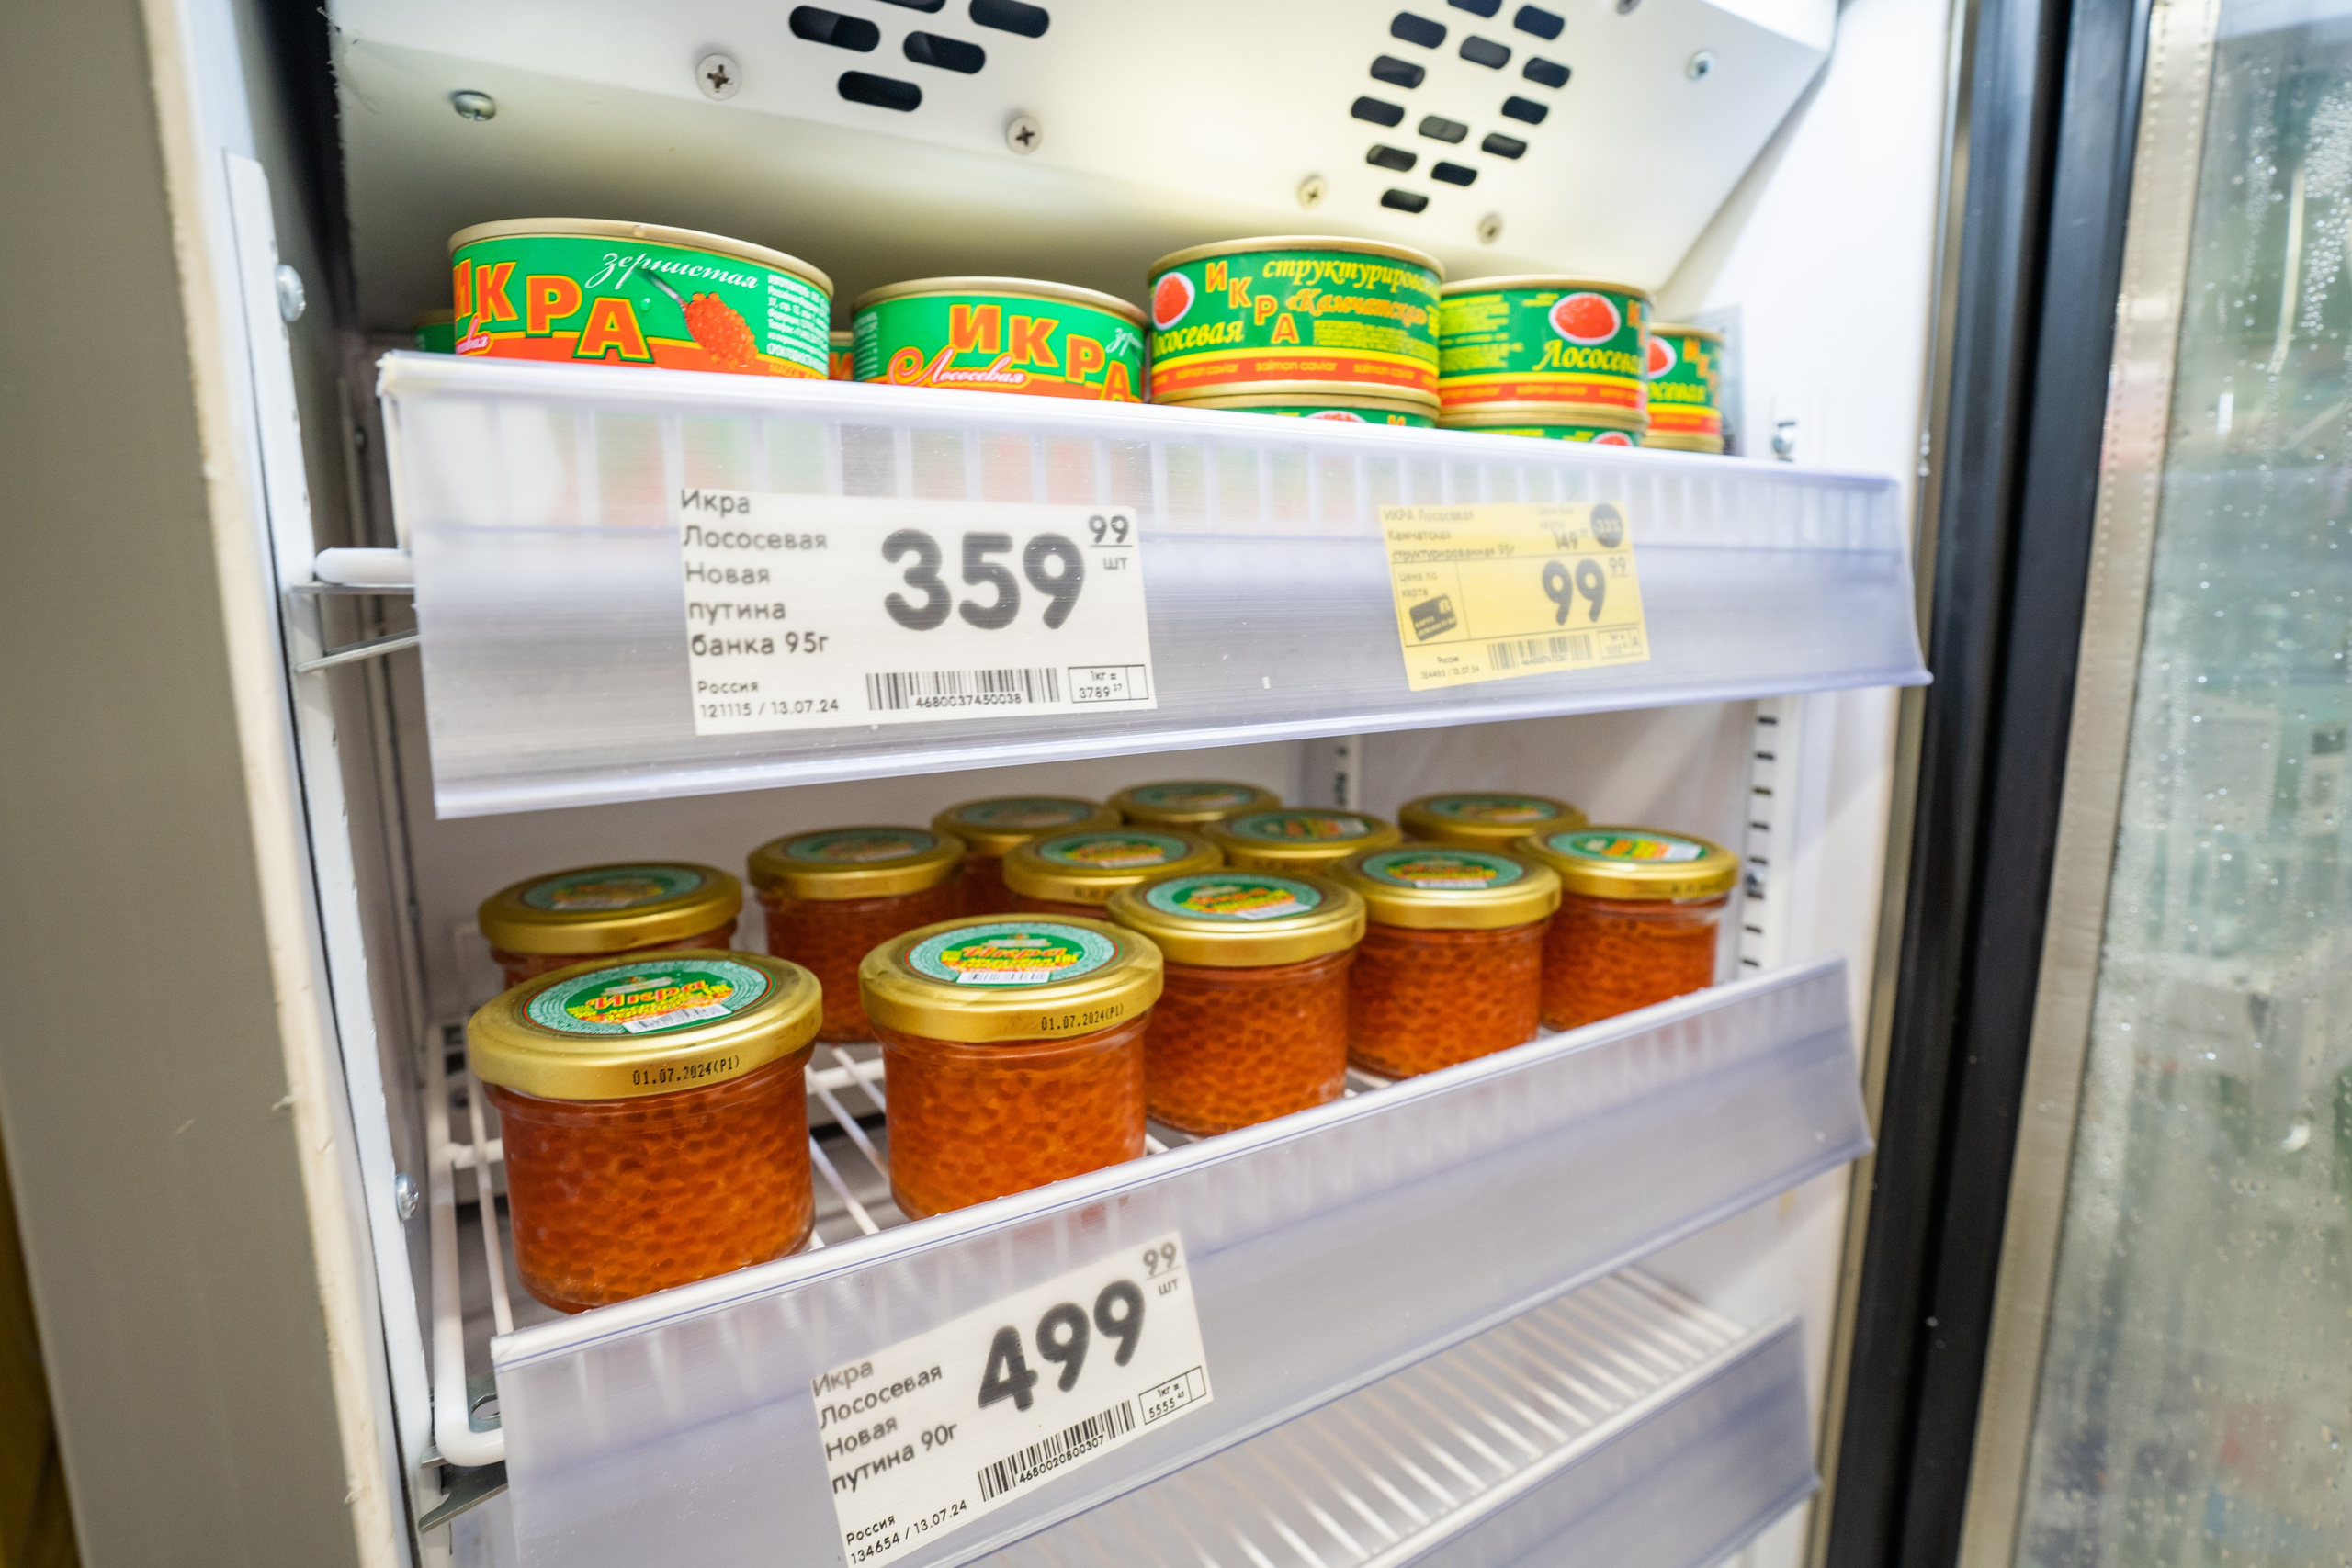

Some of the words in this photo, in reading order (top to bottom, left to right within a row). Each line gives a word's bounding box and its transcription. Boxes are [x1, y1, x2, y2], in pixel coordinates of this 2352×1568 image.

[584, 253, 759, 291] зернистая
[453, 258, 655, 363] ИКРА
[1205, 260, 1300, 344] ИКРА
[888, 347, 1026, 387] Лососевая
[949, 304, 1132, 402] ИКРА
[682, 489, 750, 516] Икра
[684, 525, 827, 549] Лососевая
[1088, 514, 1129, 544] 99
[685, 561, 770, 584] Новая
[1102, 556, 1127, 571] шт
[1609, 557, 1627, 574] 99
[882, 528, 1085, 631] 359
[1543, 558, 1606, 626] 99
[689, 602, 786, 624] путина
[692, 634, 774, 656] банка
[786, 630, 828, 653] 95г
[697, 680, 759, 694] Россия
[1091, 671, 1107, 681] 1кг
[1079, 687, 1110, 699] 3789
[701, 703, 752, 718] 121115
[772, 699, 840, 715] 13.07.24
[1143, 1242, 1177, 1276] 99
[1158, 1278, 1179, 1296] шт
[978, 1280, 1146, 1412] 499
[811, 1361, 874, 1398] Икра
[1158, 1385, 1171, 1398] 1кг
[820, 1366, 943, 1431] Лососевая
[1148, 1398, 1175, 1418] 5555
[825, 1416, 898, 1461] Новая
[831, 1444, 915, 1494] путина
[921, 1423, 957, 1452] 90г
[1019, 1434, 1105, 1483] 4680020800307
[846, 1515, 896, 1545] Россия
[851, 1532, 900, 1564] 134654
[914, 1499, 967, 1533] 13.07.24
